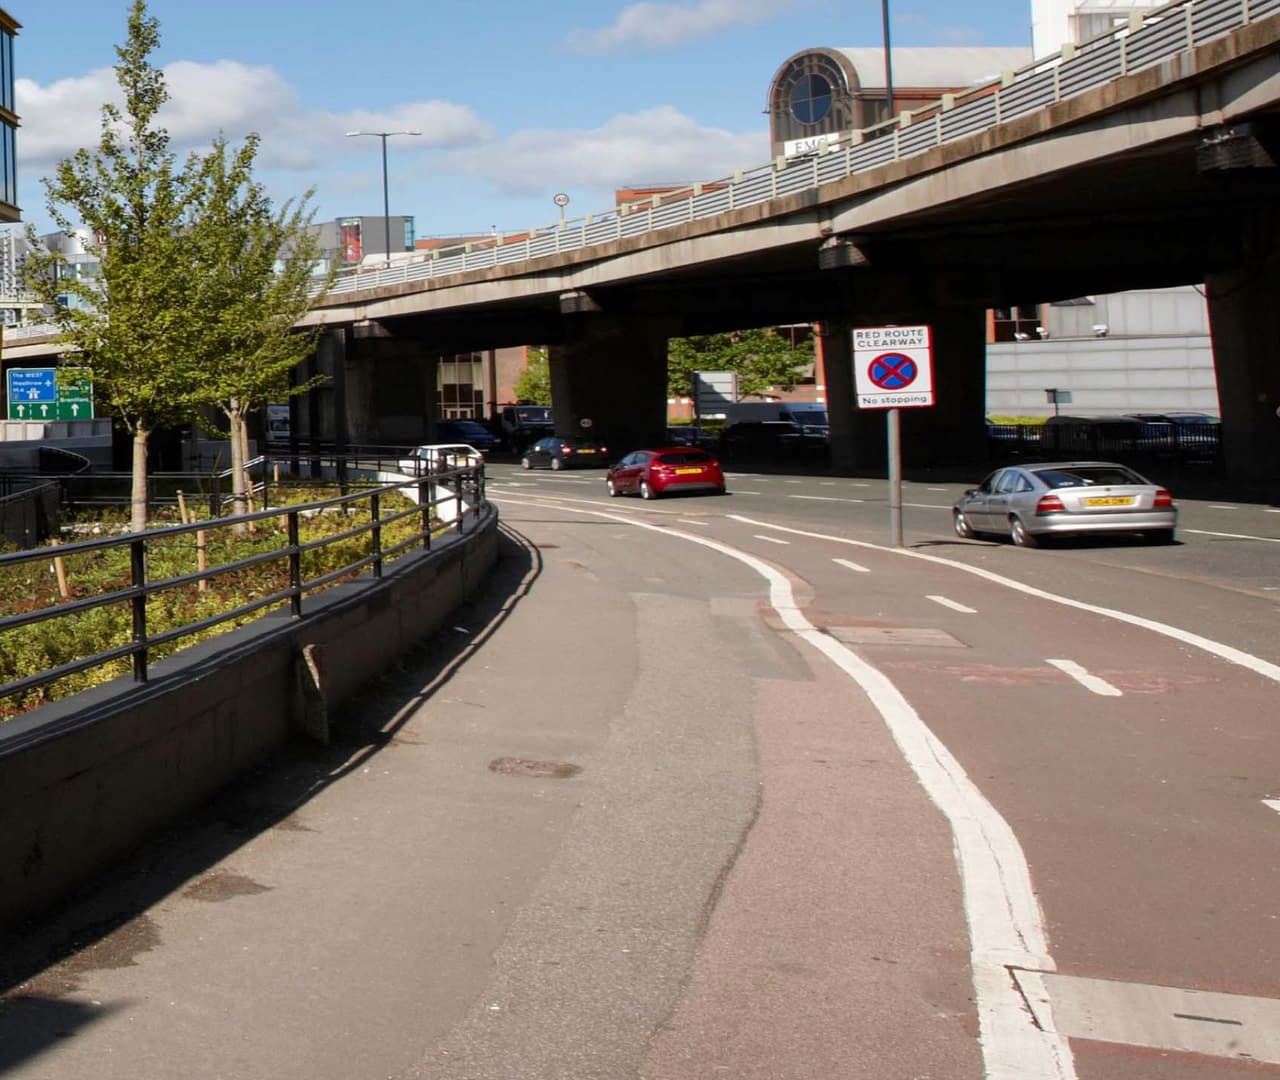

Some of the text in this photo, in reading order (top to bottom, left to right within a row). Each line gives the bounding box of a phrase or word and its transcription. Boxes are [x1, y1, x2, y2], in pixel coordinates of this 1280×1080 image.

[856, 329, 924, 339] RED ROUTE
[858, 338, 924, 348] CLEARWAY
[881, 396, 927, 405] stopping
